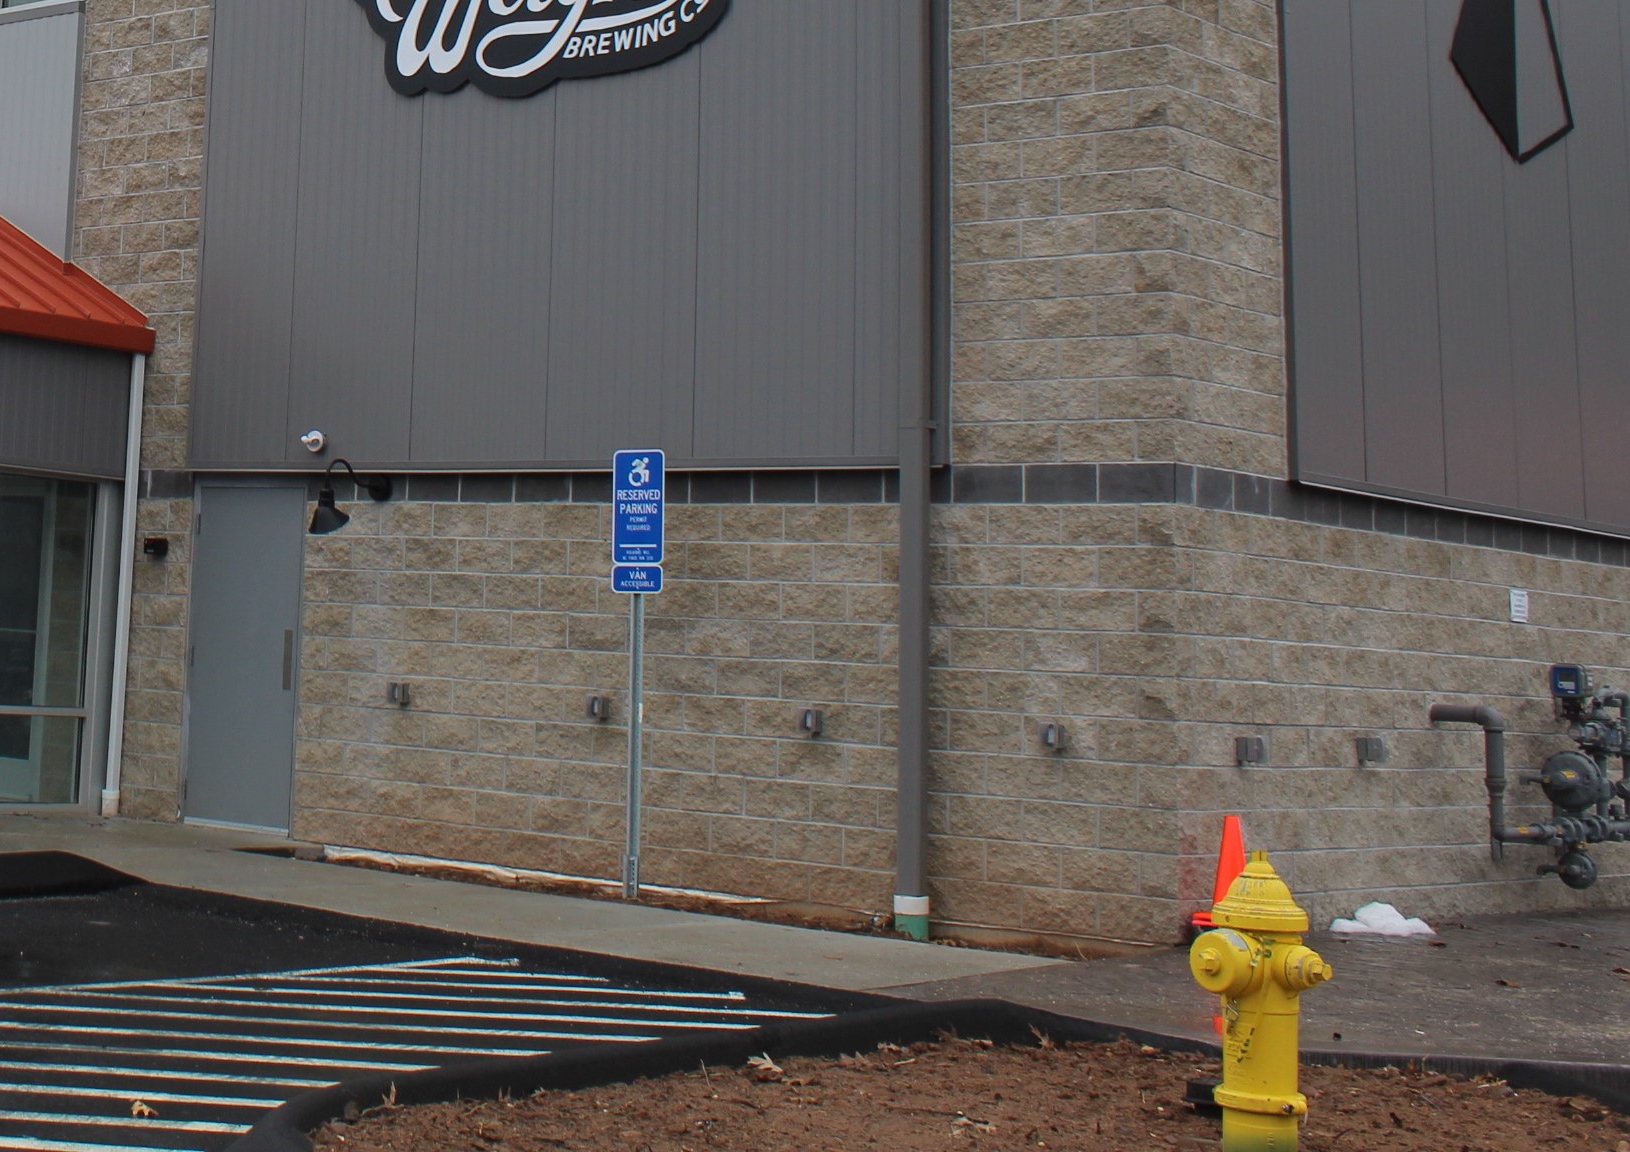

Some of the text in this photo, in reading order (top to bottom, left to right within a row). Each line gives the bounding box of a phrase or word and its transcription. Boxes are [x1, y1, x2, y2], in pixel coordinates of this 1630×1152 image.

[562, 11, 677, 59] BREWING
[616, 489, 661, 501] RESERVED
[619, 503, 658, 514] PARKING
[629, 571, 647, 580] VAN
[620, 580, 655, 588] ACCESSIBLE
